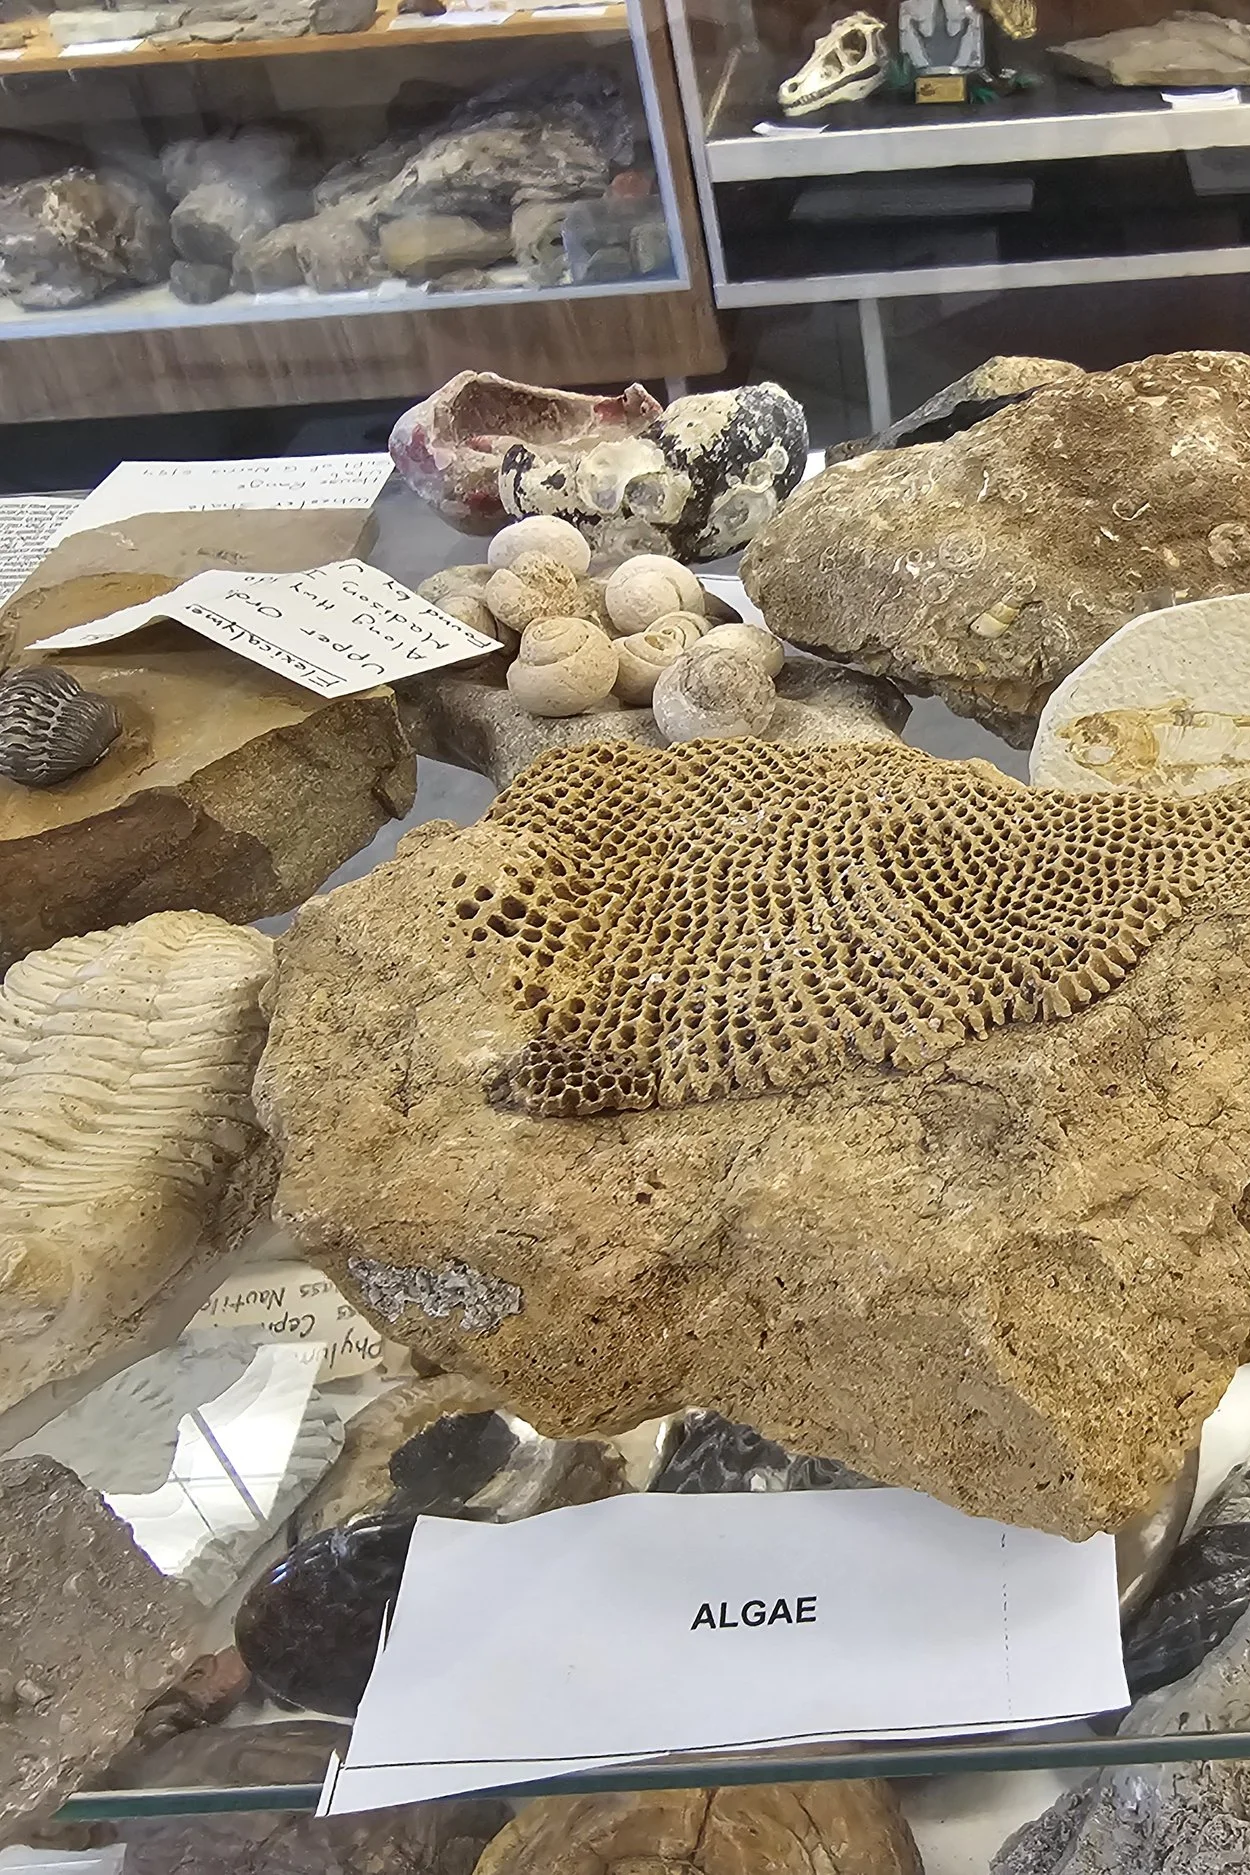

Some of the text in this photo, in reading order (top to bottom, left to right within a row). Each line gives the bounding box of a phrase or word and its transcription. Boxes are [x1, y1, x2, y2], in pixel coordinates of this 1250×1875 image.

[383, 581, 410, 601] by
[352, 613, 427, 660] Along
[418, 609, 491, 648] Found
[299, 628, 384, 675] Upper
[690, 1596, 817, 1631] ALGAE
